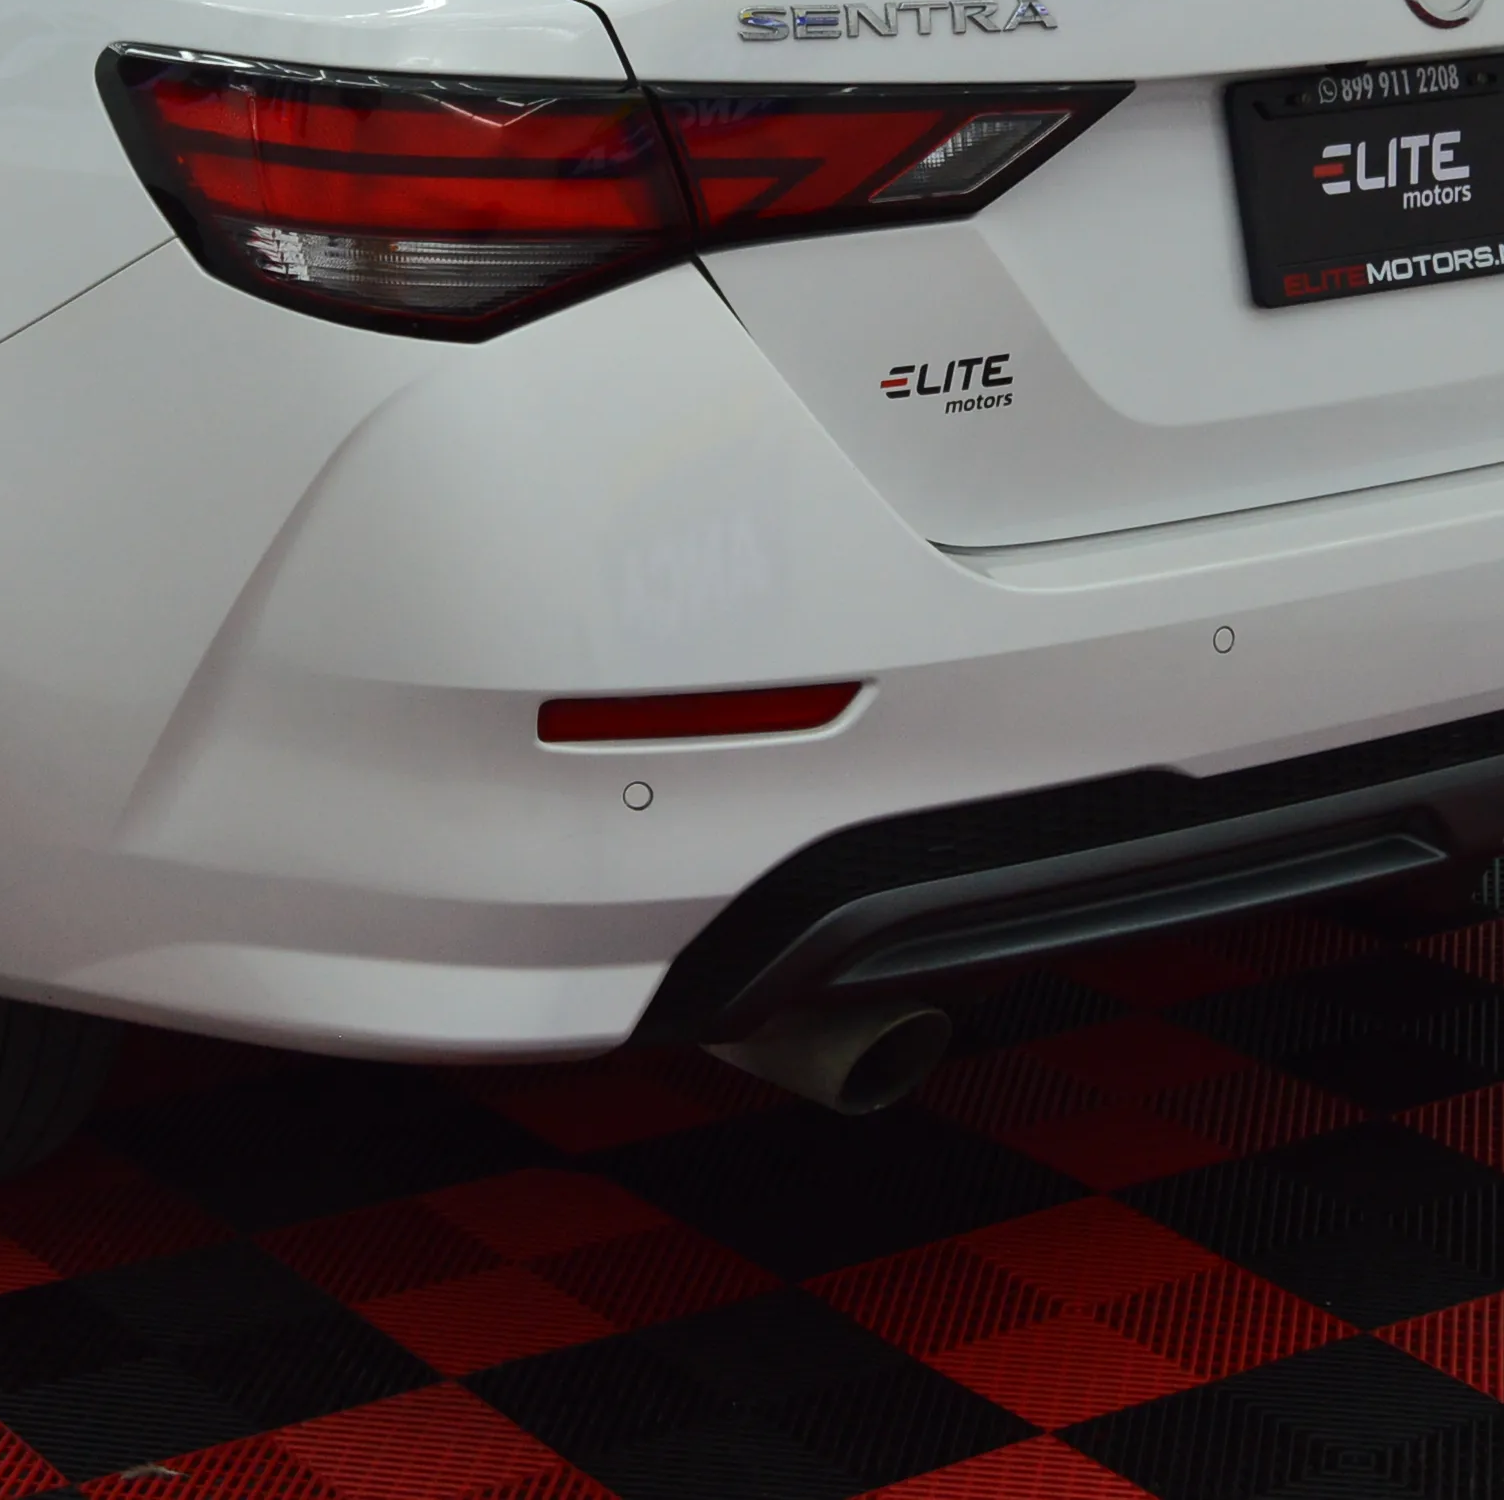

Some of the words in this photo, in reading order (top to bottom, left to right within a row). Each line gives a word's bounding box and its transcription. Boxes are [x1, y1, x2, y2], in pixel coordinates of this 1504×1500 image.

[1341, 72, 1373, 102] 899
[1378, 69, 1410, 98] 911
[1416, 64, 1460, 94] 2208
[1312, 130, 1470, 196] ELITE
[1403, 184, 1472, 210] motors
[880, 353, 1013, 399] ELITE
[945, 393, 1013, 415] motors
